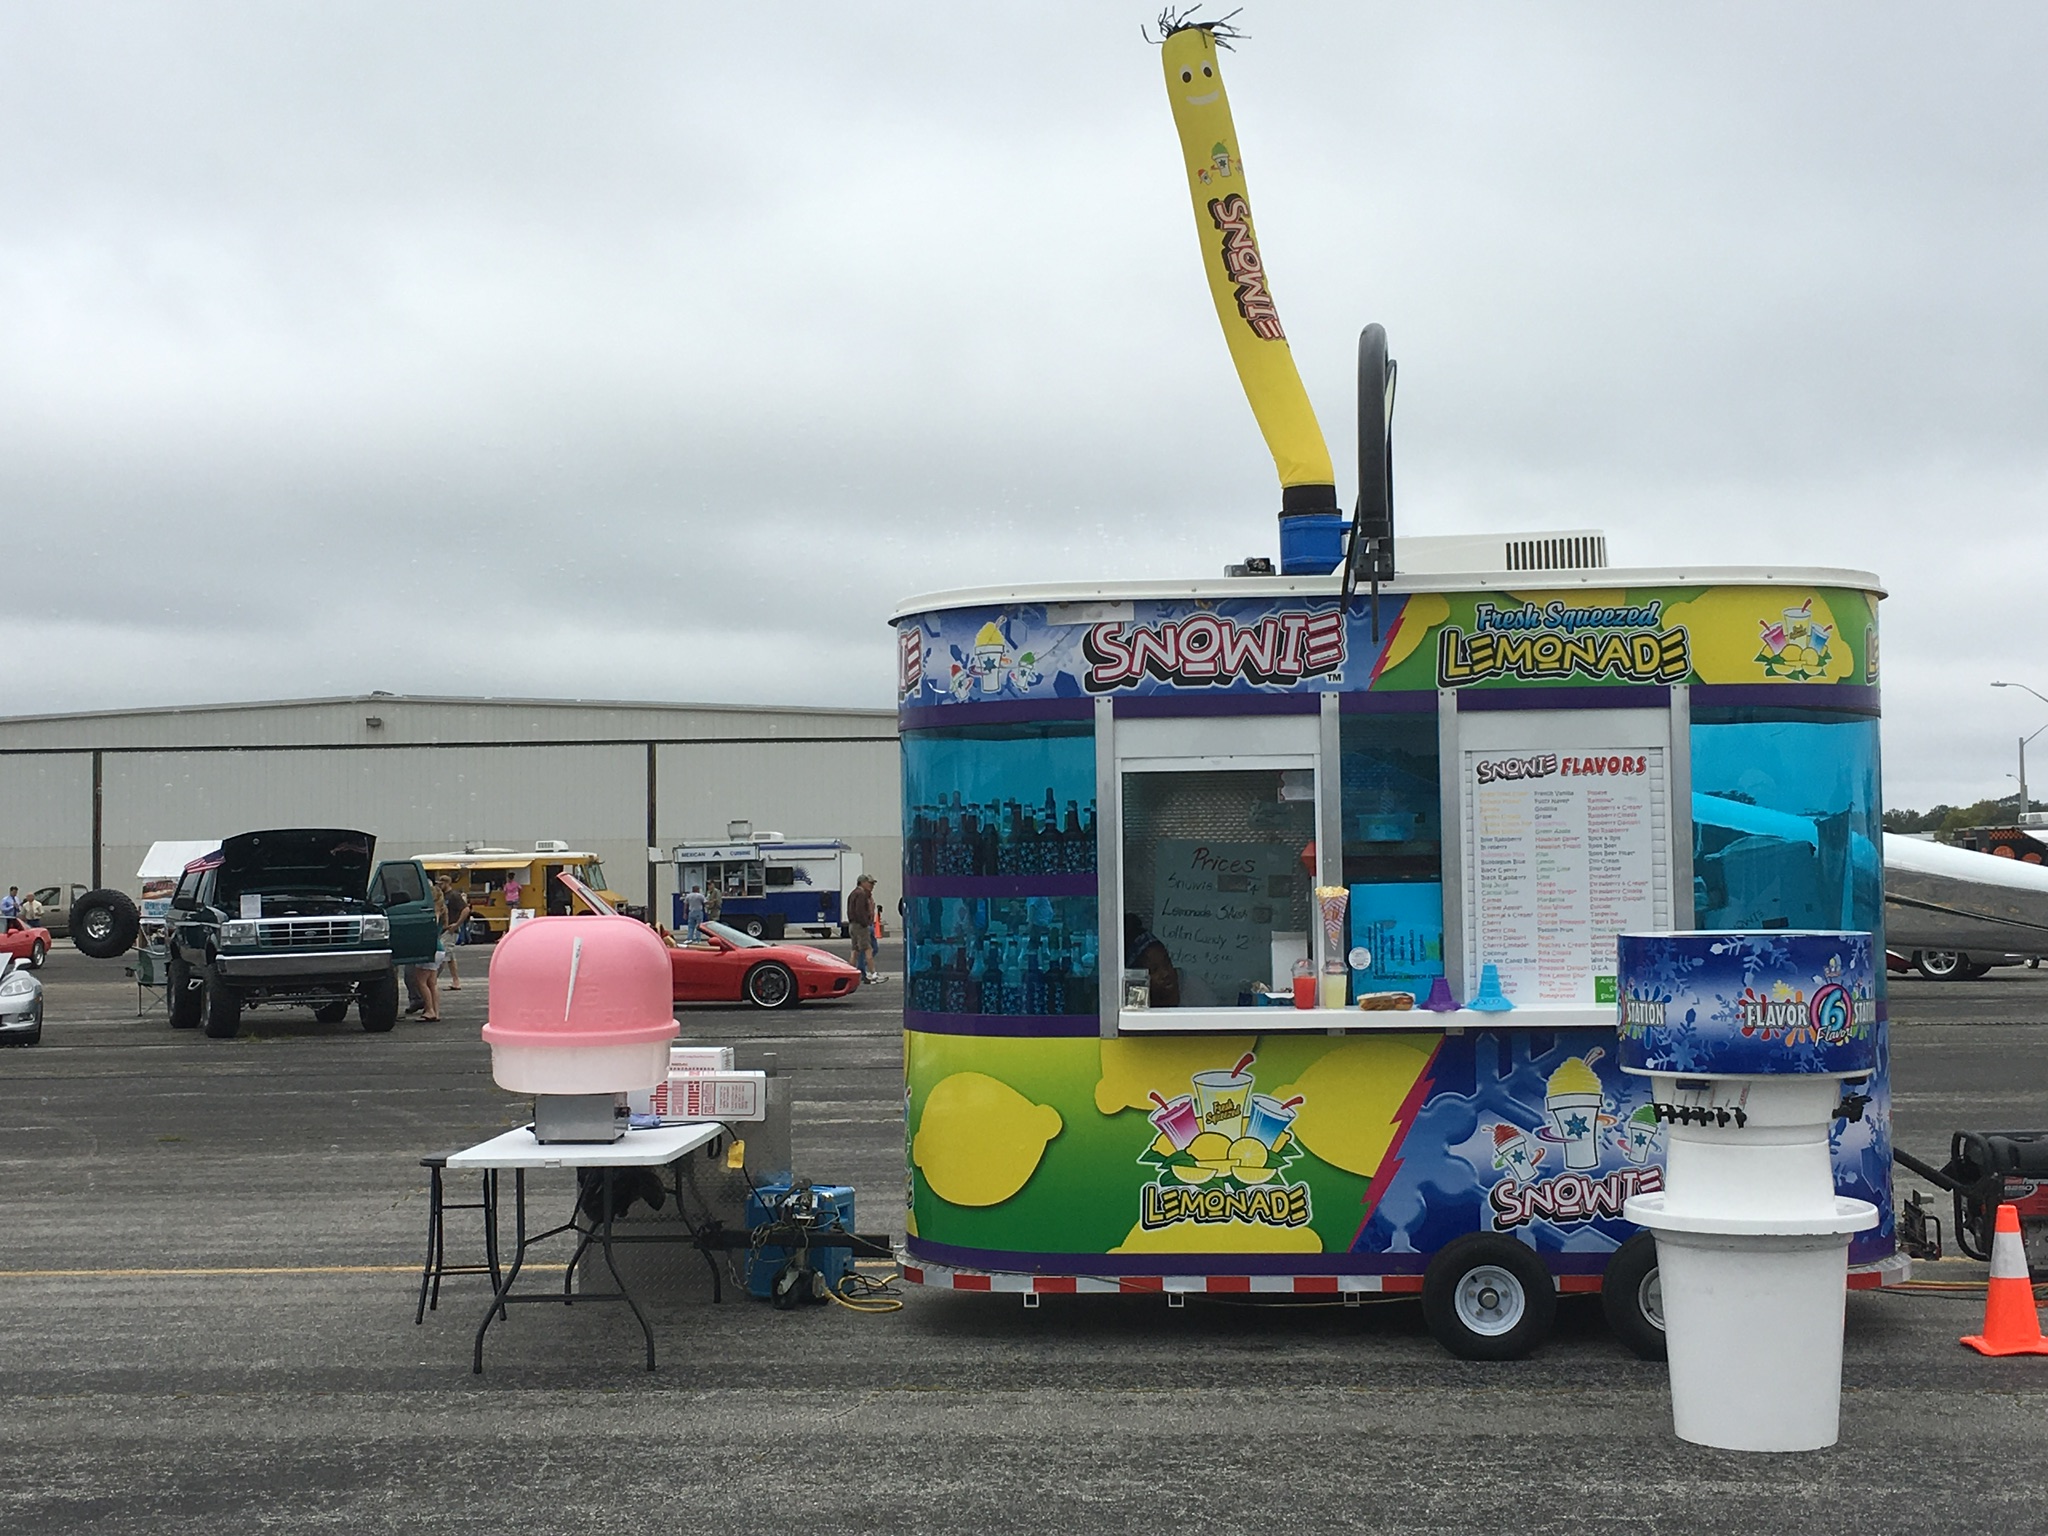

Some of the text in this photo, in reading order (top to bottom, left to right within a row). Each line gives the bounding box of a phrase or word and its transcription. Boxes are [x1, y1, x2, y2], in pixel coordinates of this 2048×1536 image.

[1208, 193, 1285, 340] SNOWIE
[1476, 600, 1660, 633] Fresh Squeezed
[1084, 611, 1346, 690] SNOWIE
[1438, 628, 1691, 688] LEMONADE
[1477, 754, 1647, 784] SNOWIE FLAVORS
[1191, 847, 1256, 873] Prices
[1161, 897, 1212, 918] Lemonade
[1627, 1002, 1664, 1025] STATION
[1747, 1004, 1808, 1026] FLAVOR
[1815, 1025, 1853, 1047] Flavor
[1205, 1098, 1242, 1125] Fresh Squeezed
[1142, 1184, 1311, 1230] LEMONADE
[1490, 1166, 1665, 1231] SNOWIE
